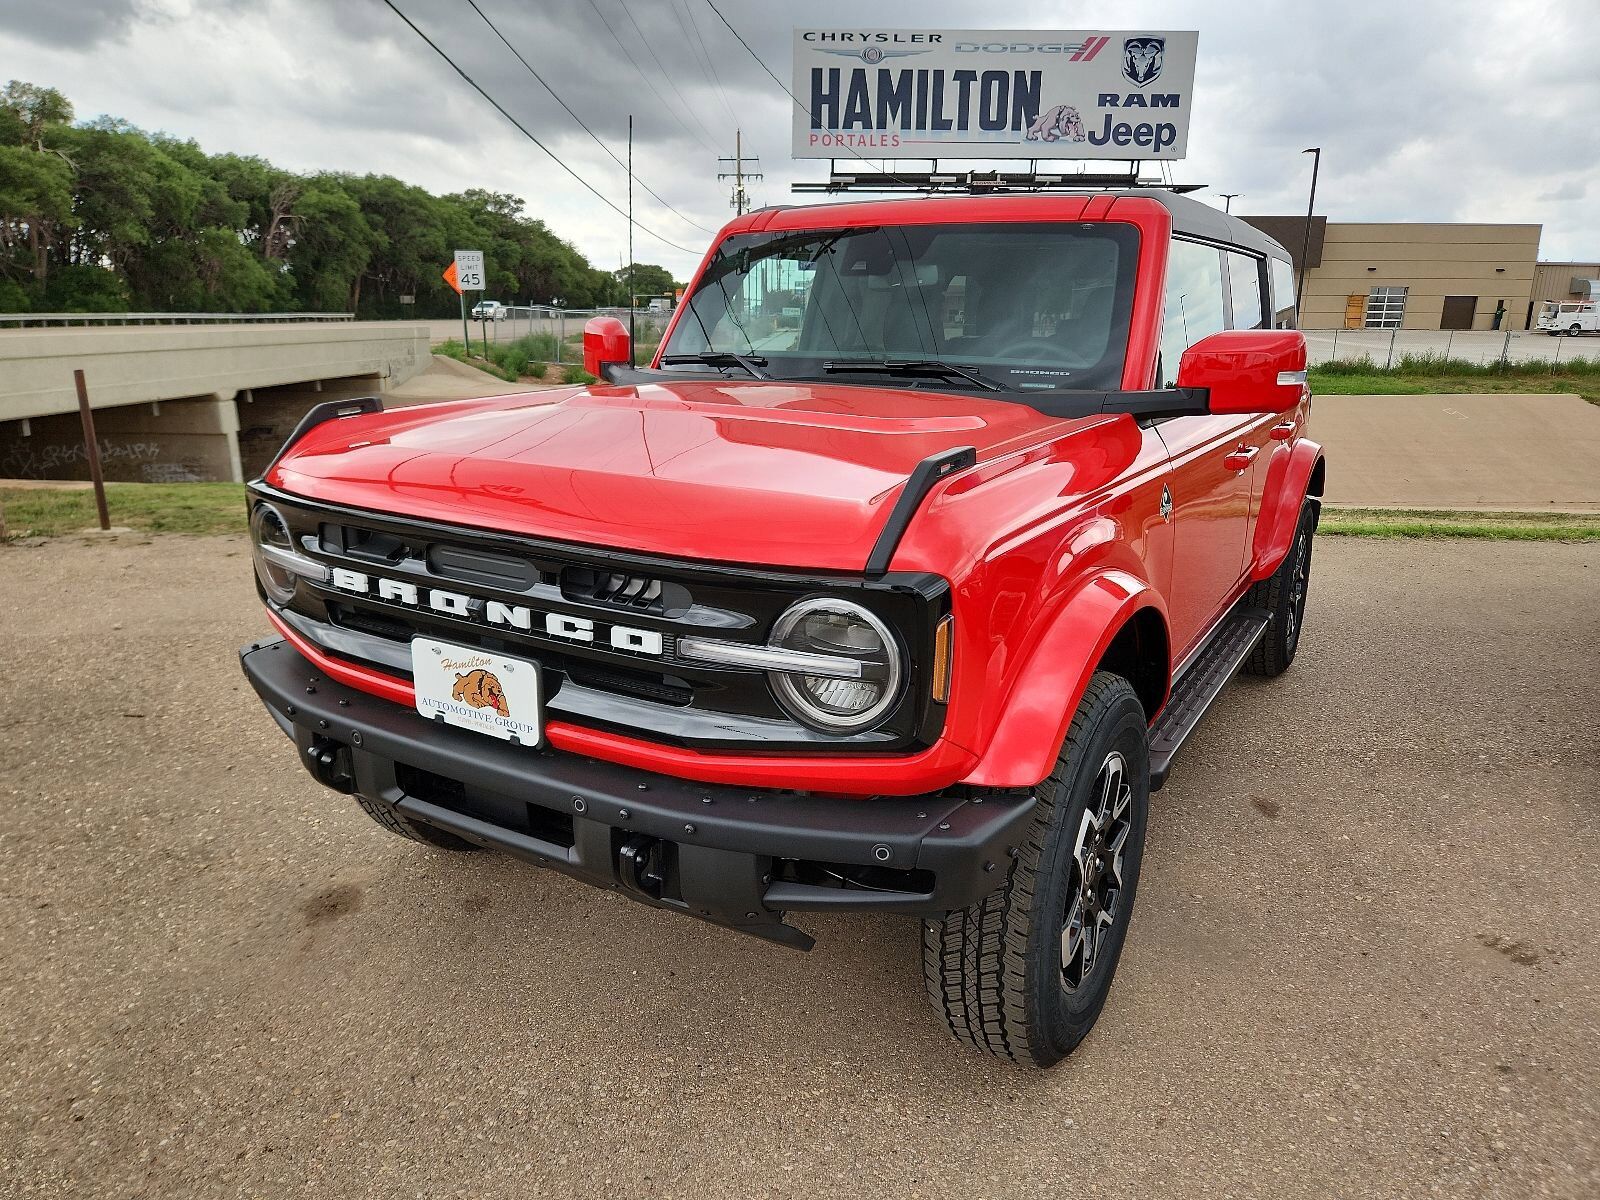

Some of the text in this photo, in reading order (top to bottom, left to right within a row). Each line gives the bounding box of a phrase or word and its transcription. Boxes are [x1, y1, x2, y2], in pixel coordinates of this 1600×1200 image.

[803, 32, 943, 43] CHRYSLER
[955, 43, 1087, 54] DODGE
[810, 67, 1043, 131] HAMILTON
[1097, 93, 1181, 108] RAM
[809, 133, 900, 147] PORTALES
[1087, 113, 1177, 153] Jeep
[461, 274, 480, 285] 45
[333, 567, 663, 655] BRONCO
[441, 656, 493, 672] Hamilton
[421, 697, 493, 723] AUTOMOTIVE
[494, 719, 533, 734] GROUP
